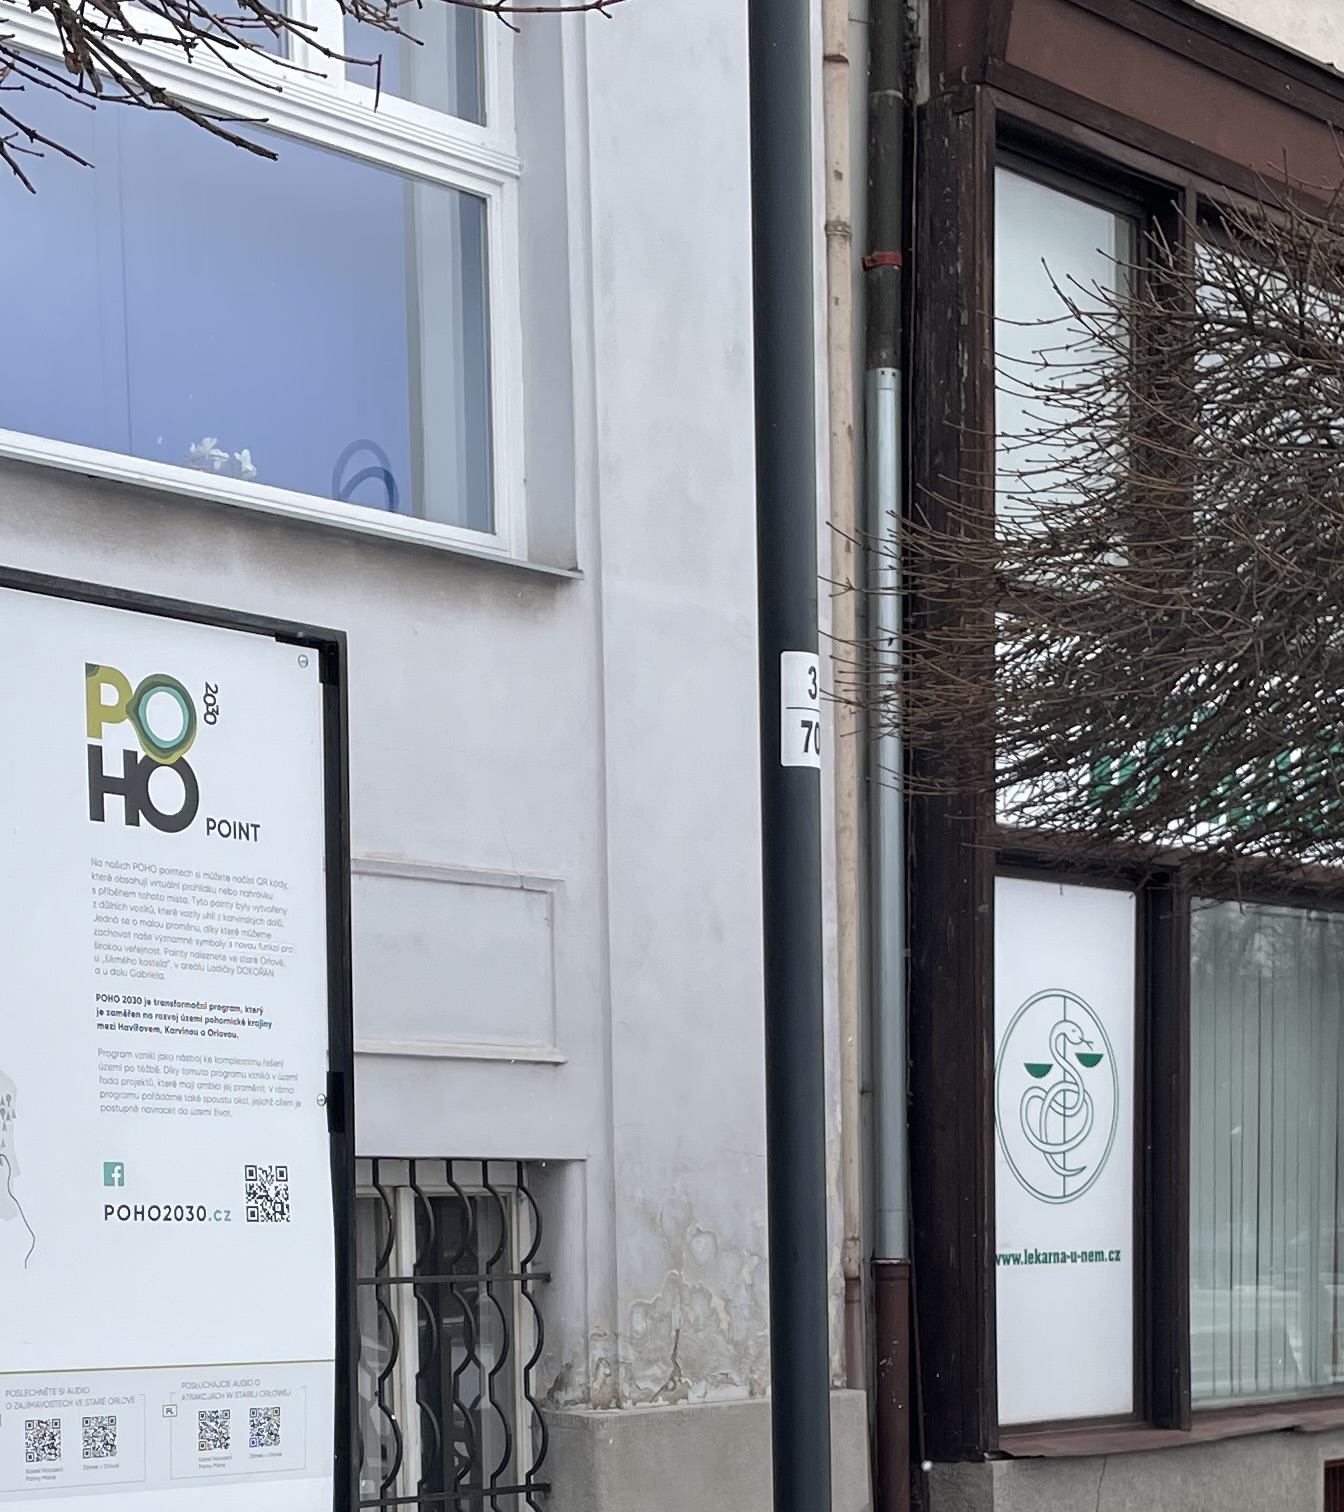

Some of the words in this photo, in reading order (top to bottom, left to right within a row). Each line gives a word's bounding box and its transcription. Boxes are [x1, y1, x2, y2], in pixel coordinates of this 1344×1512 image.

[202, 681, 220, 726] 2030
[205, 817, 261, 842] POINT
[95, 993, 120, 1003] POHO
[121, 995, 142, 1005] 2030
[143, 997, 152, 1007] je
[208, 1004, 243, 1013] program,
[244, 1005, 264, 1016] který
[104, 1204, 231, 1221] POHO2030.cz
